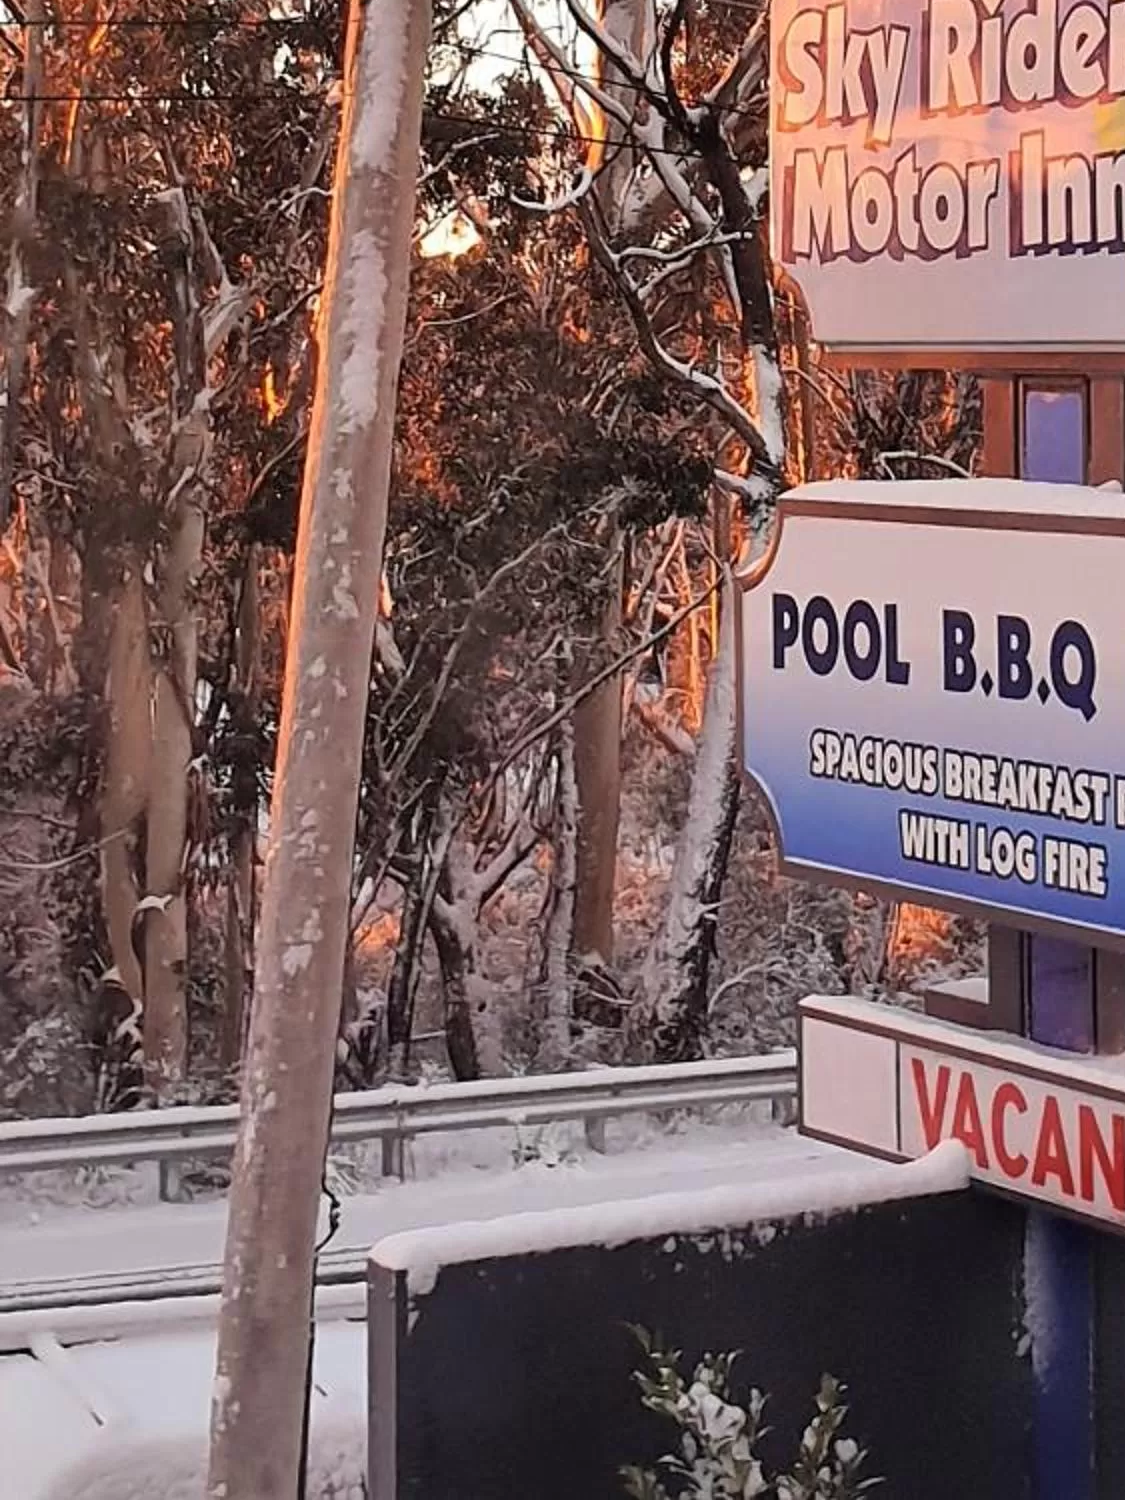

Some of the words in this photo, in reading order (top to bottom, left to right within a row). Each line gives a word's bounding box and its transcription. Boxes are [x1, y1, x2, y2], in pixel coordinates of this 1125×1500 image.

[779, 3, 909, 150] Sky
[784, 145, 1000, 263] Motor
[772, 593, 911, 686] POOL
[942, 608, 1098, 722] B.B.Q
[809, 728, 940, 797] SPACIOUS
[943, 749, 1110, 824] BREAKFAST
[899, 808, 970, 870] WITH
[974, 822, 1037, 884] LOG
[1043, 837, 1108, 898] FIRE
